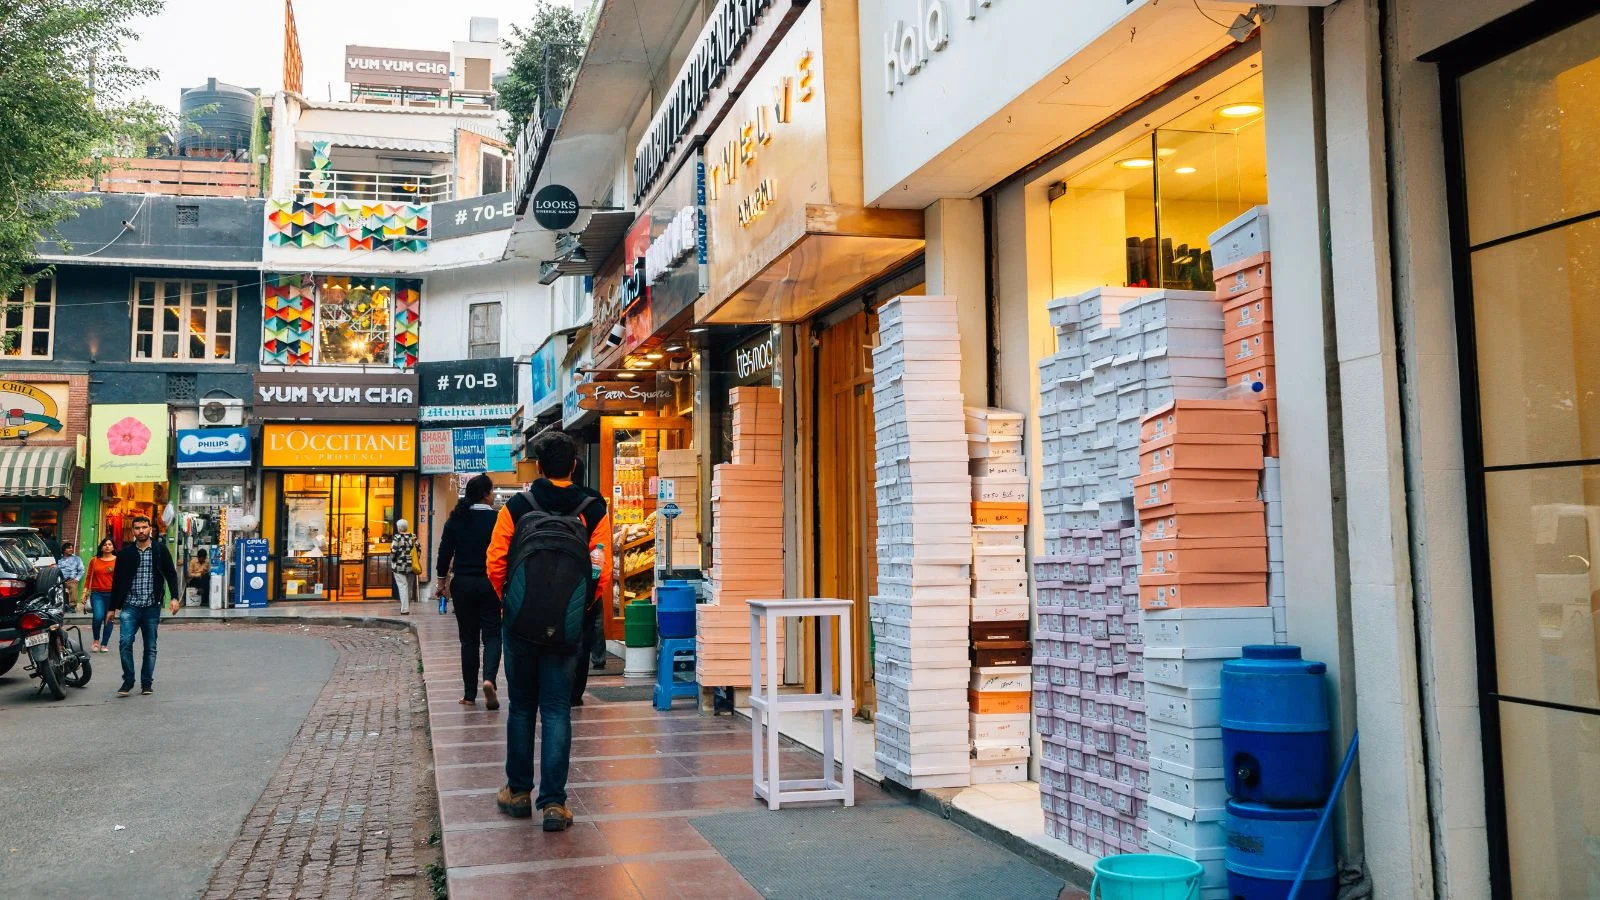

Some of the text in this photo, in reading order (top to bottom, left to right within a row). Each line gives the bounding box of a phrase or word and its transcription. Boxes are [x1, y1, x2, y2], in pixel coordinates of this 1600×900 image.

[347, 57, 447, 74] YUM YUM CHA
[708, 50, 816, 200] TWELVE
[535, 200, 577, 210] LOOKS
[455, 202, 514, 225] # 70-B
[437, 372, 498, 391] # 70-B
[2, 382, 35, 397] CHILL
[259, 386, 413, 404] YUM YUM CHA
[627, 385, 672, 403] Square
[422, 431, 451, 442] BHARAT
[198, 440, 229, 448] PHILIPS
[429, 443, 446, 454] HAIR
[318, 453, 384, 461] PROVENCE
[422, 455, 452, 465] DRESSERS
[454, 458, 487, 470] JEWELLERS
